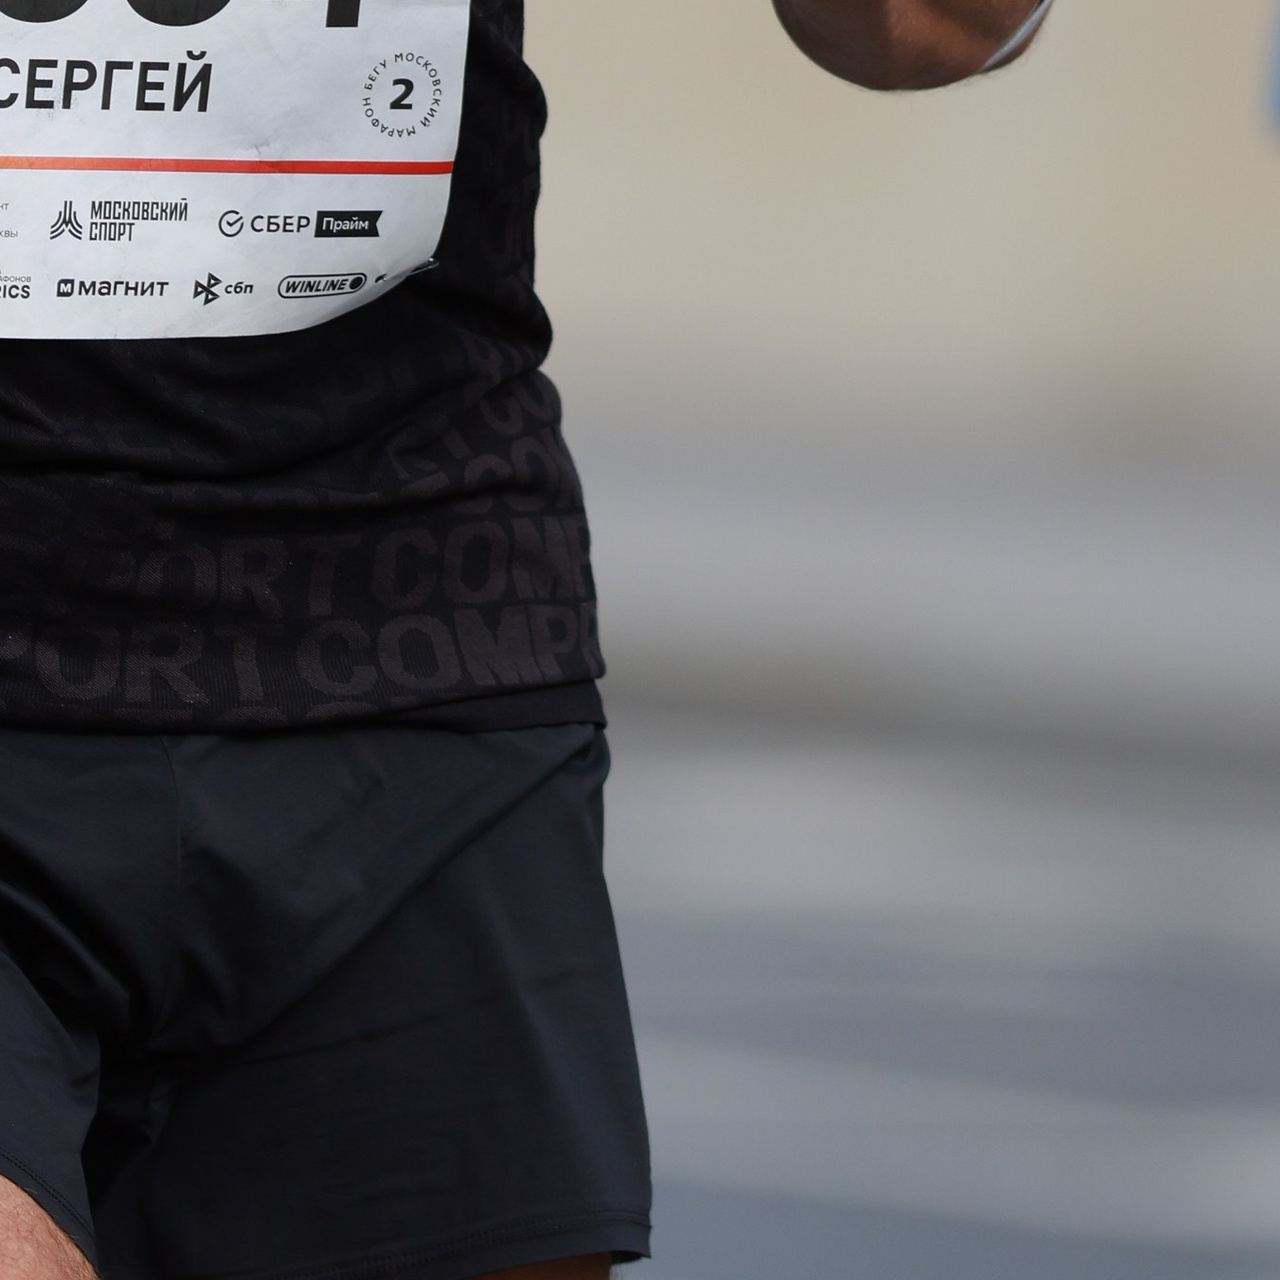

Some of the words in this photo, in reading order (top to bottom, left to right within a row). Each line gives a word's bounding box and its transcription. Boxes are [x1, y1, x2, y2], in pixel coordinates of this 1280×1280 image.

[364, 59, 387, 90] БЕГУ
[389, 78, 415, 110] 2
[394, 52, 442, 128] МОСКОВСКИЙ
[362, 97, 416, 138] МАРАФОН
[90, 197, 189, 222] МОСКОВСКИЙ
[89, 222, 136, 242] СПОРТ
[250, 215, 311, 233] СБЕР
[322, 216, 370, 233] Прайм
[78, 280, 170, 297] магнит
[224, 281, 254, 295] сбп
[284, 278, 349, 294] WINLINE
